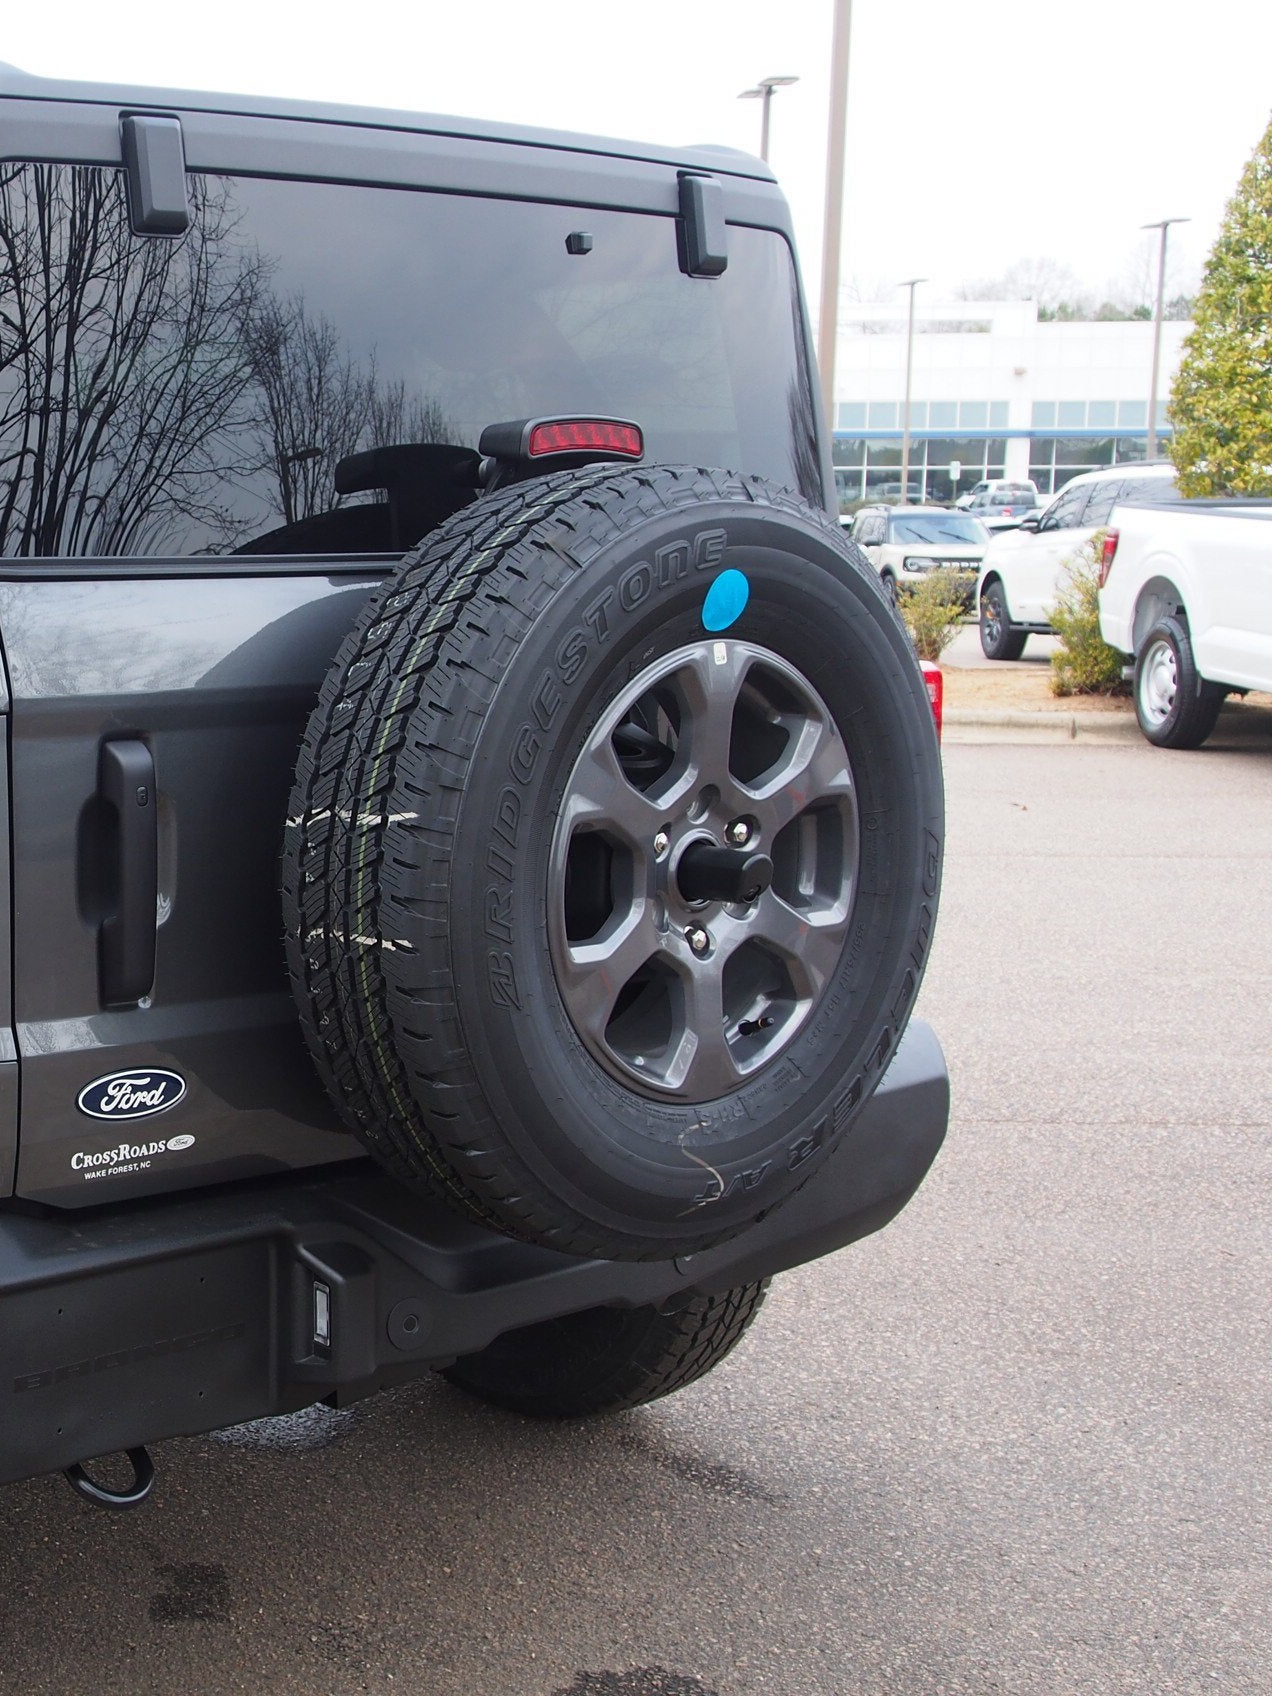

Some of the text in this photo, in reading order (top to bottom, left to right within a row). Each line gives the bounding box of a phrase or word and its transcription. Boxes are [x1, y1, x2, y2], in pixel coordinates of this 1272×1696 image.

[483, 527, 730, 1009] BRIDGESTONE
[785, 828, 942, 1170] DUELER
[100, 1077, 167, 1112] Ford
[84, 1160, 151, 1180] WAKE FOREST, NC
[692, 1160, 772, 1202] A/T
